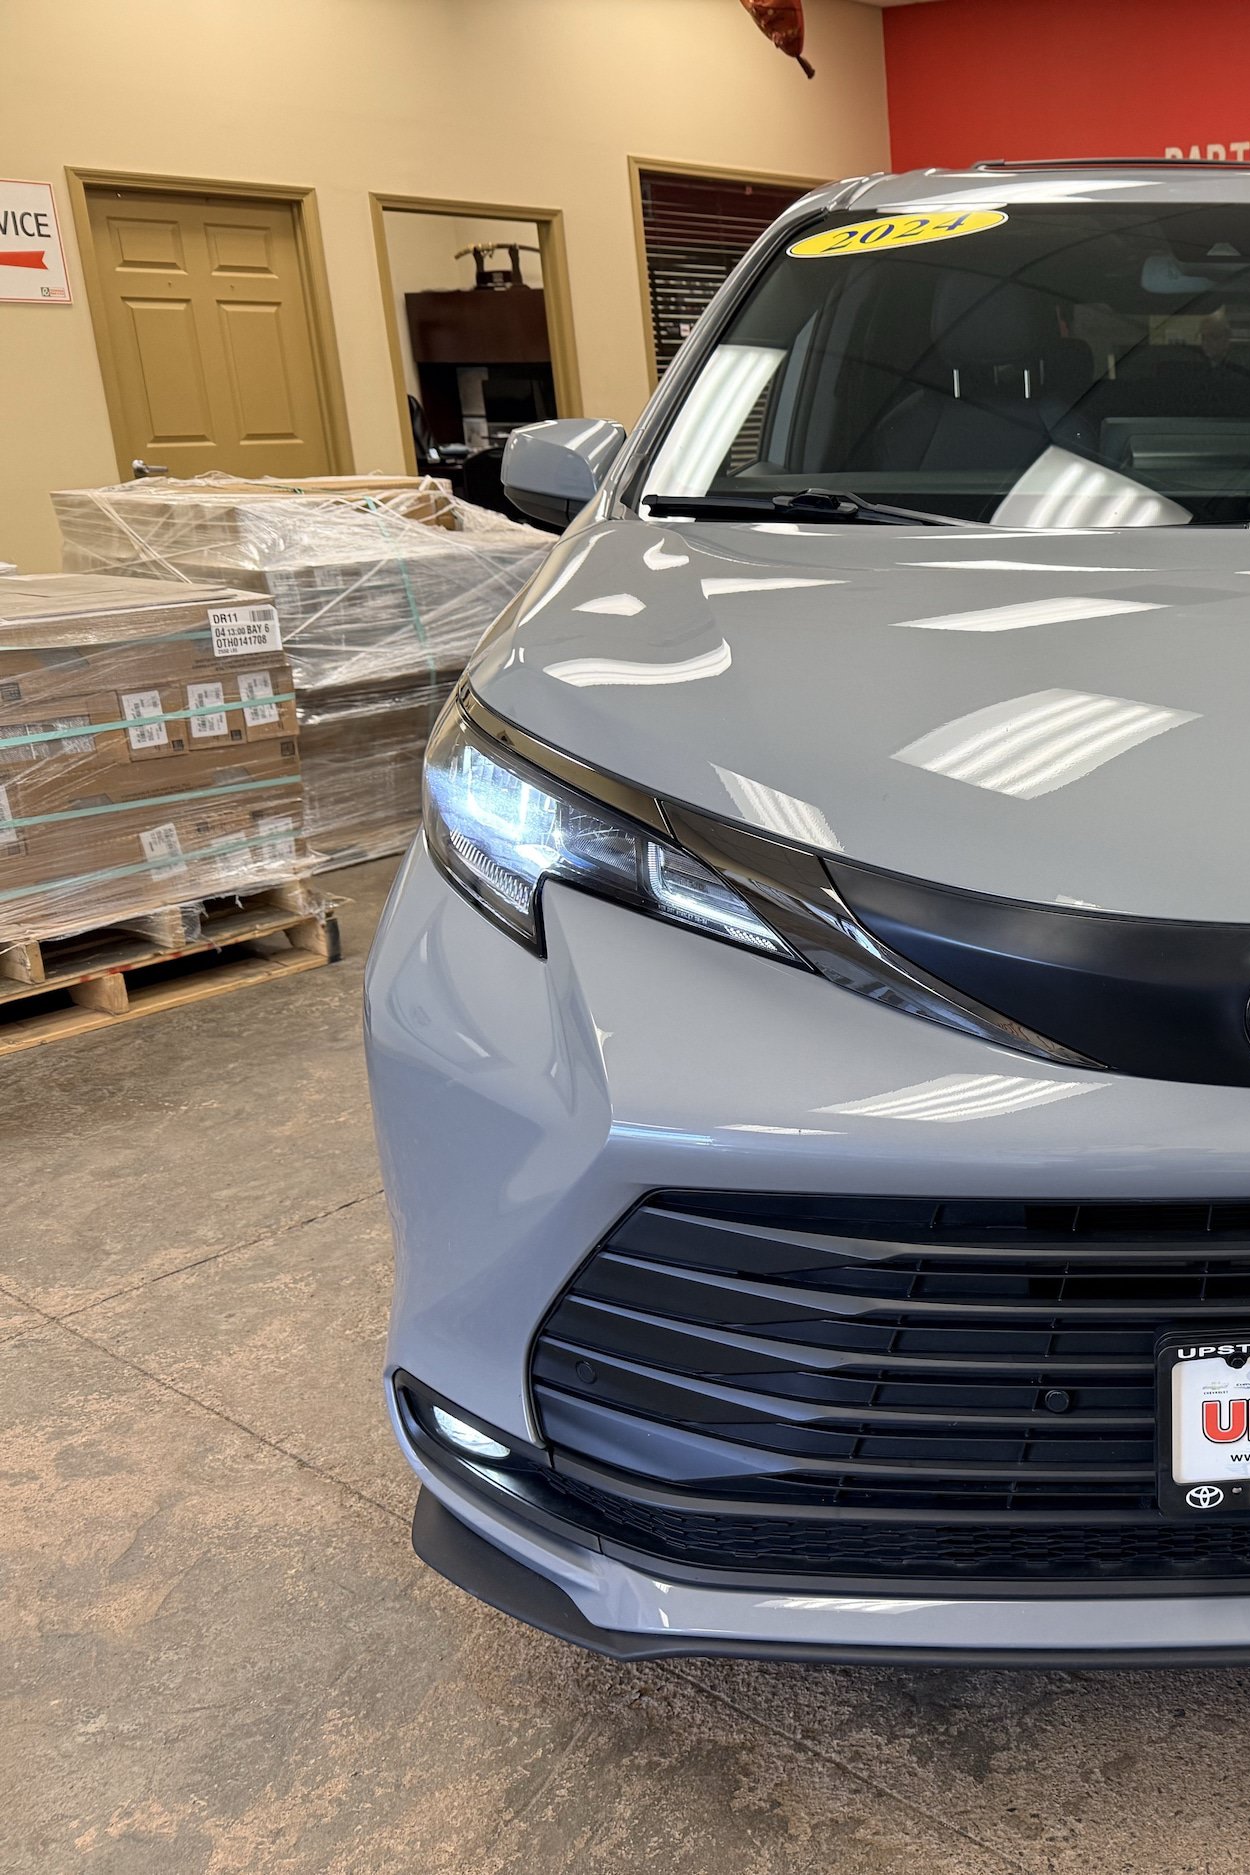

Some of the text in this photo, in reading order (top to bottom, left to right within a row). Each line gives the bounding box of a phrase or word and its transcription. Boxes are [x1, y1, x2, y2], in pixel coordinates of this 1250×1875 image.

[821, 212, 971, 252] 2024
[212, 613, 238, 624] DR11
[215, 627, 226, 638] 04
[247, 624, 262, 635] BAY
[264, 624, 270, 633] 6
